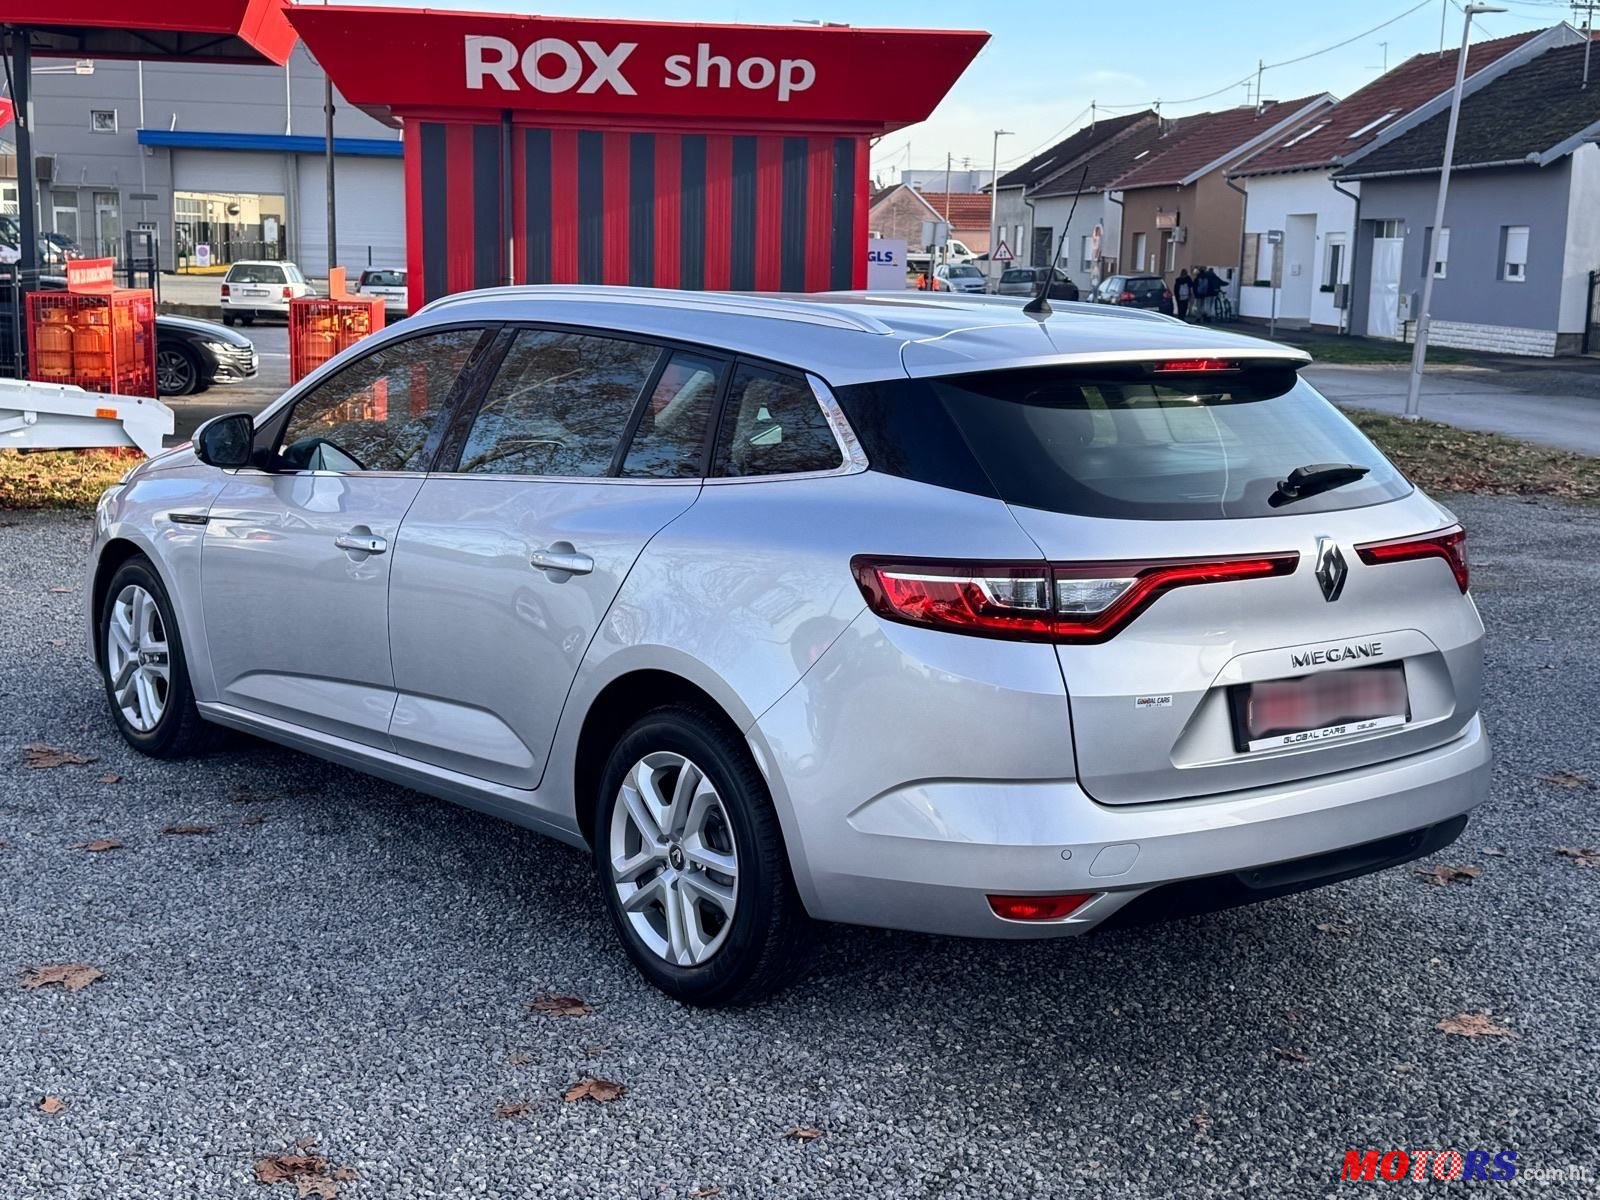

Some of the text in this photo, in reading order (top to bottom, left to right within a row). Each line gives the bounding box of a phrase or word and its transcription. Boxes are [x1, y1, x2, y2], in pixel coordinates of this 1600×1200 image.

[464, 35, 816, 102] ROX shop
[868, 251, 893, 262] GLS
[1291, 642, 1384, 668] MEGANE
[1283, 732, 1320, 744] GLOBAL
[1322, 726, 1346, 737] CARS
